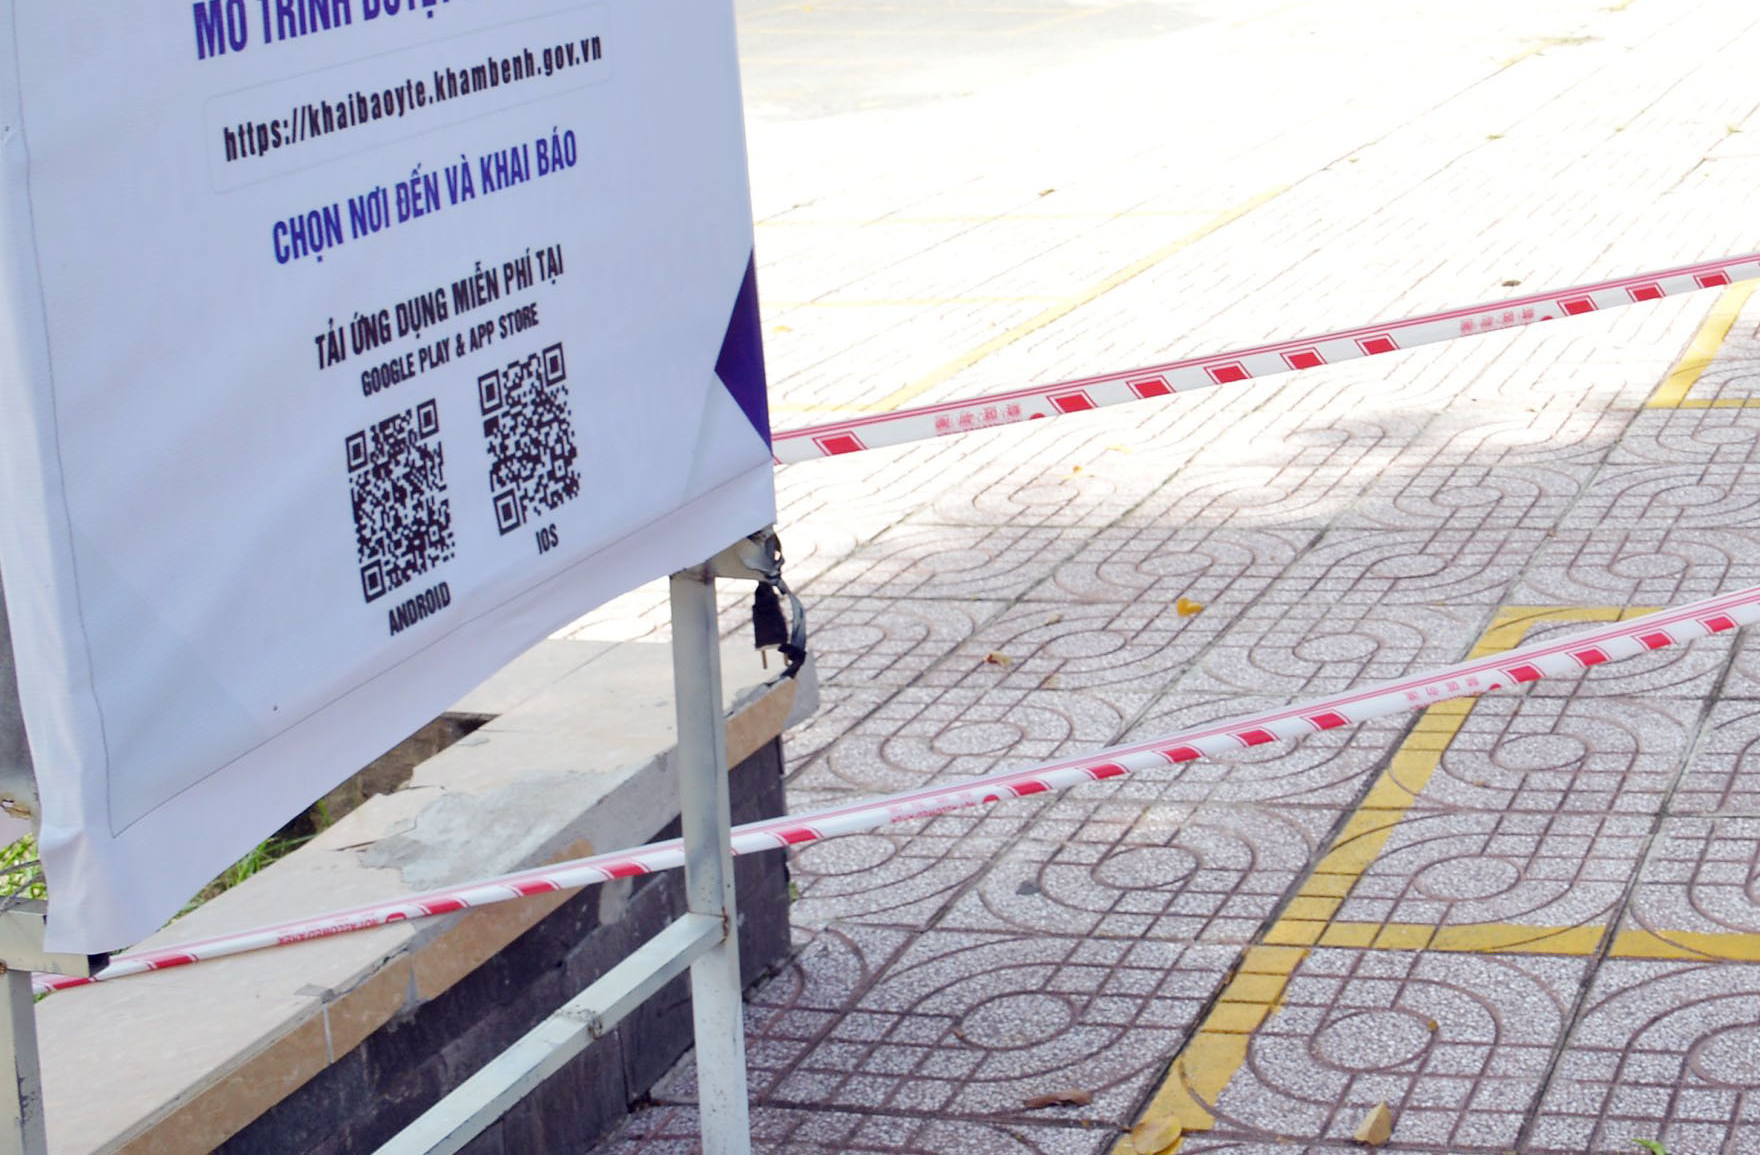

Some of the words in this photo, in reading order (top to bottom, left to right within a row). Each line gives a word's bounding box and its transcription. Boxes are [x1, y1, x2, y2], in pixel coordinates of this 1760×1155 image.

[223, 34, 603, 163] https://khaibaoyte.khambenh.gov.vn
[272, 203, 344, 265] CHỌN
[349, 186, 391, 240] NƠI
[394, 163, 441, 224] ĐẾN
[445, 154, 476, 206] VÀ
[479, 144, 531, 195] KHAI
[535, 127, 577, 178] BÁO
[314, 317, 347, 370] TẢI
[351, 310, 392, 356] ỨNG
[395, 290, 449, 339] DỤNG
[451, 260, 500, 317] MIỄN
[503, 247, 534, 296] PHÍ
[535, 244, 564, 286] TẠI
[360, 352, 416, 397] GOOGLE
[419, 338, 450, 373] PLAY
[455, 333, 466, 358] &
[469, 320, 495, 353] APP
[499, 303, 540, 340] STORE
[535, 524, 559, 555] IOS
[388, 581, 451, 636] ANDROID
